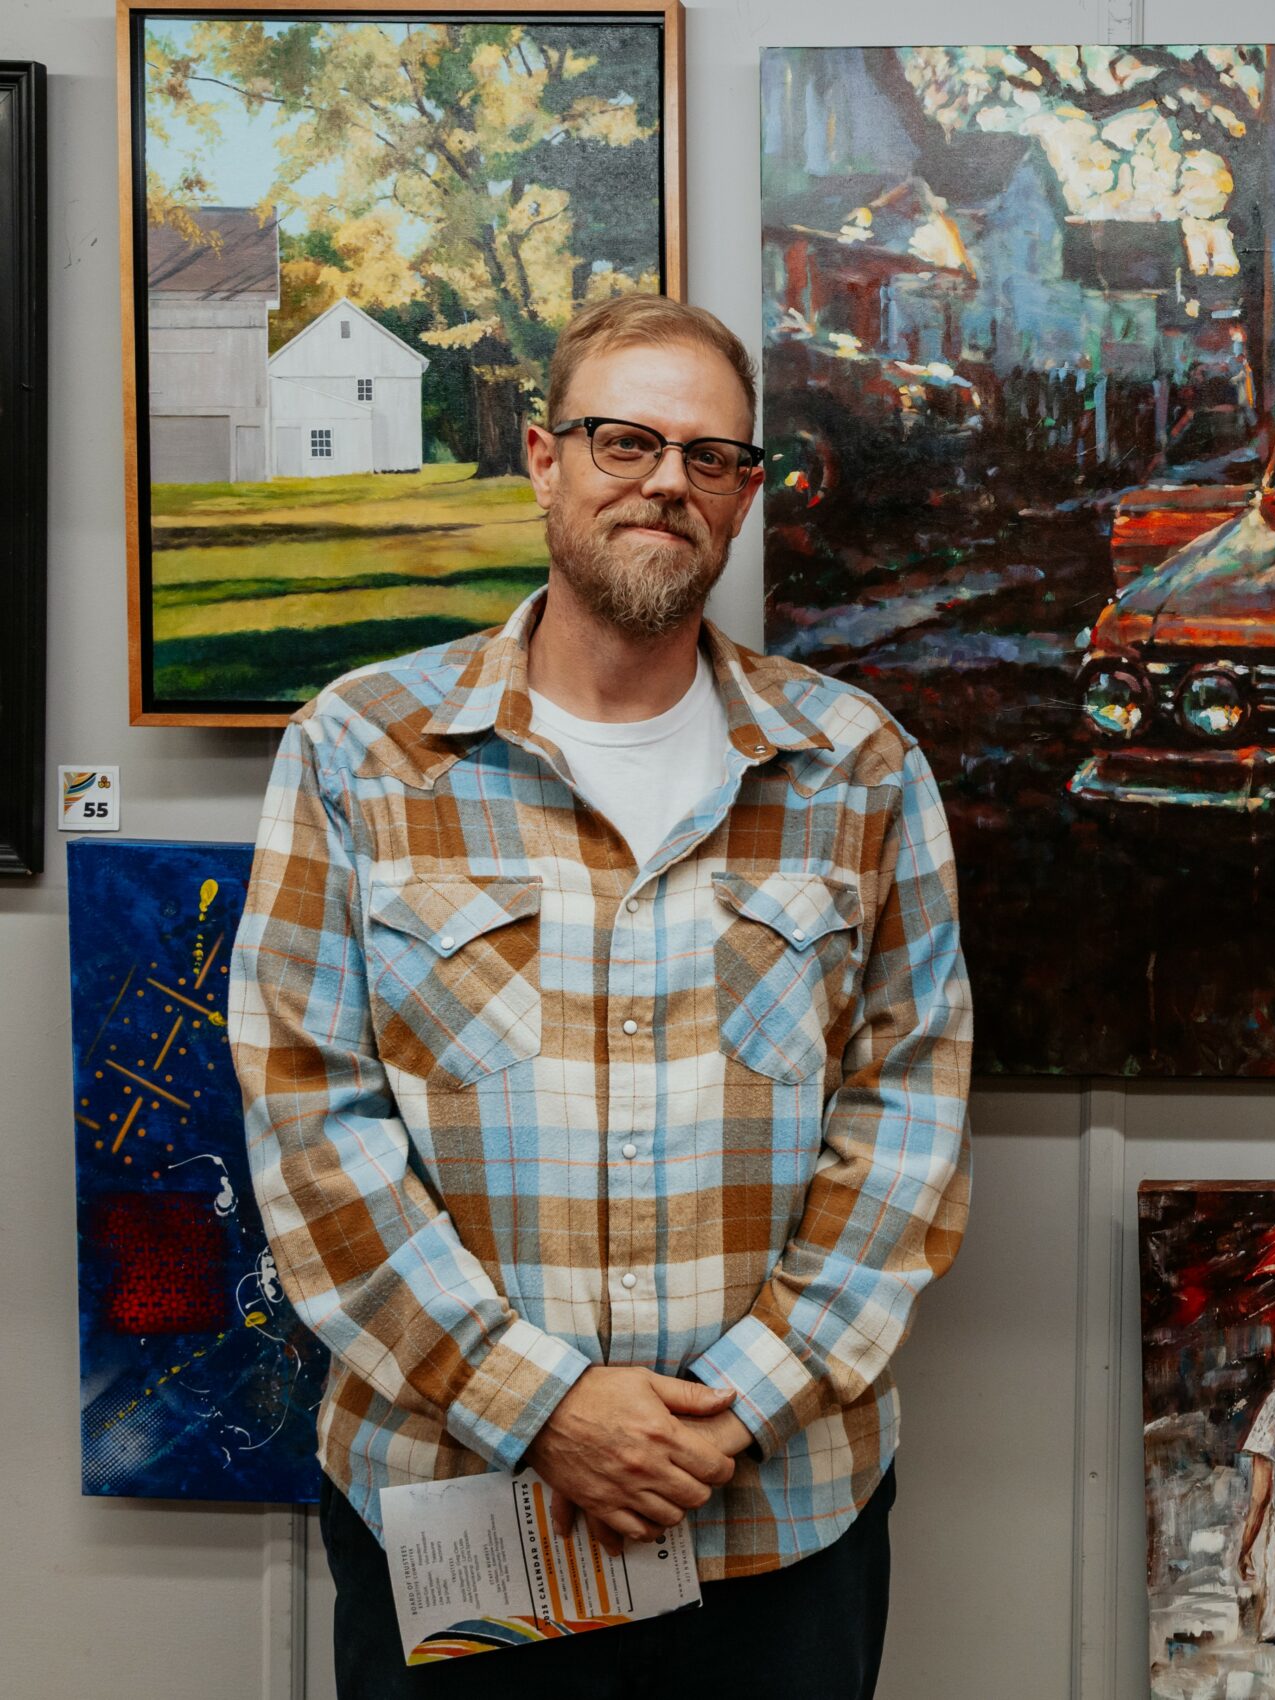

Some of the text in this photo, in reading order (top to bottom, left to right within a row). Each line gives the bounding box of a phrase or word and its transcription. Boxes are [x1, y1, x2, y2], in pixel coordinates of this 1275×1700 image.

[83, 802, 109, 818] 55
[400, 1545, 417, 1615] BOARD OF TRUSTEES
[521, 1483, 550, 1625] 2025 CALENDAR OF EVENTS
